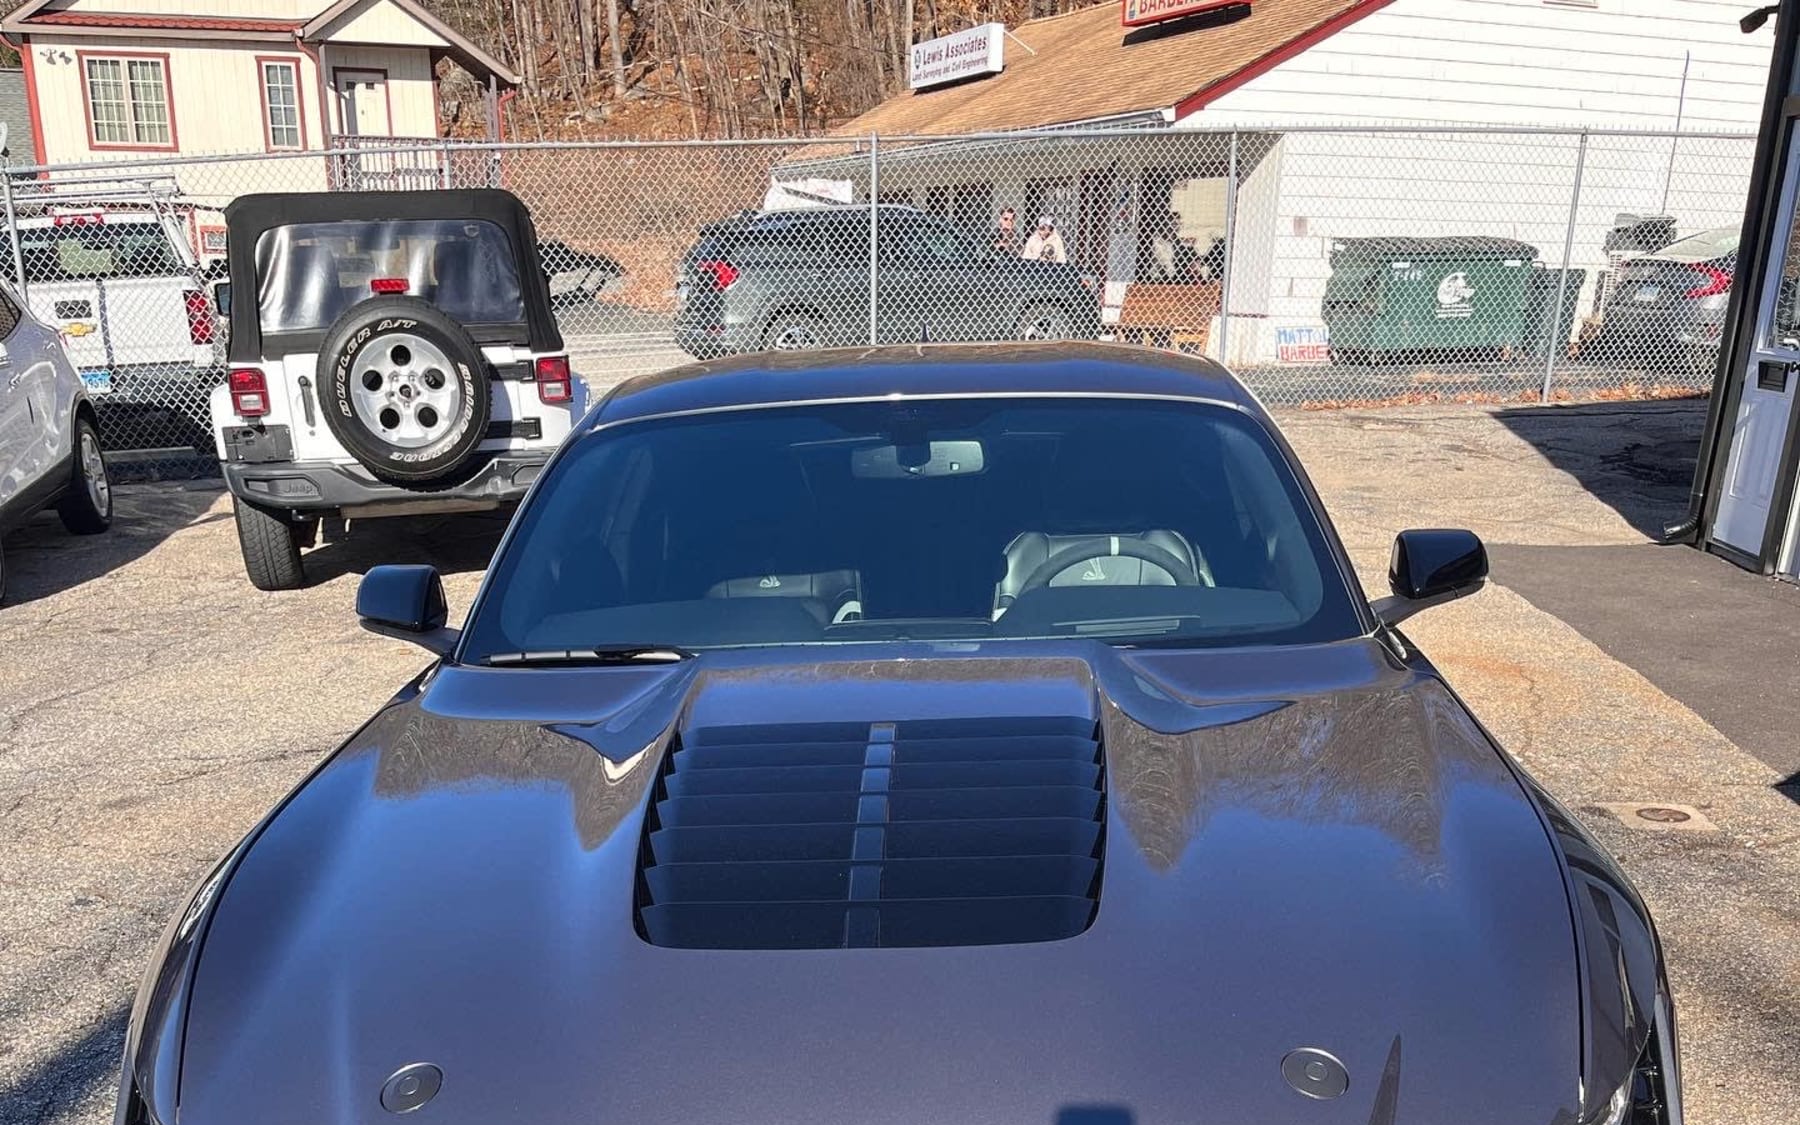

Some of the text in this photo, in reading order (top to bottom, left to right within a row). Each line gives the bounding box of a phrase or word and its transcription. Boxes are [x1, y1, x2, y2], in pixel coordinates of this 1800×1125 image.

[923, 36, 987, 65] Lewis Associates
[1280, 345, 1329, 361] BARBE
[336, 319, 417, 418] DUELER A/T
[284, 483, 314, 495] Jeep
